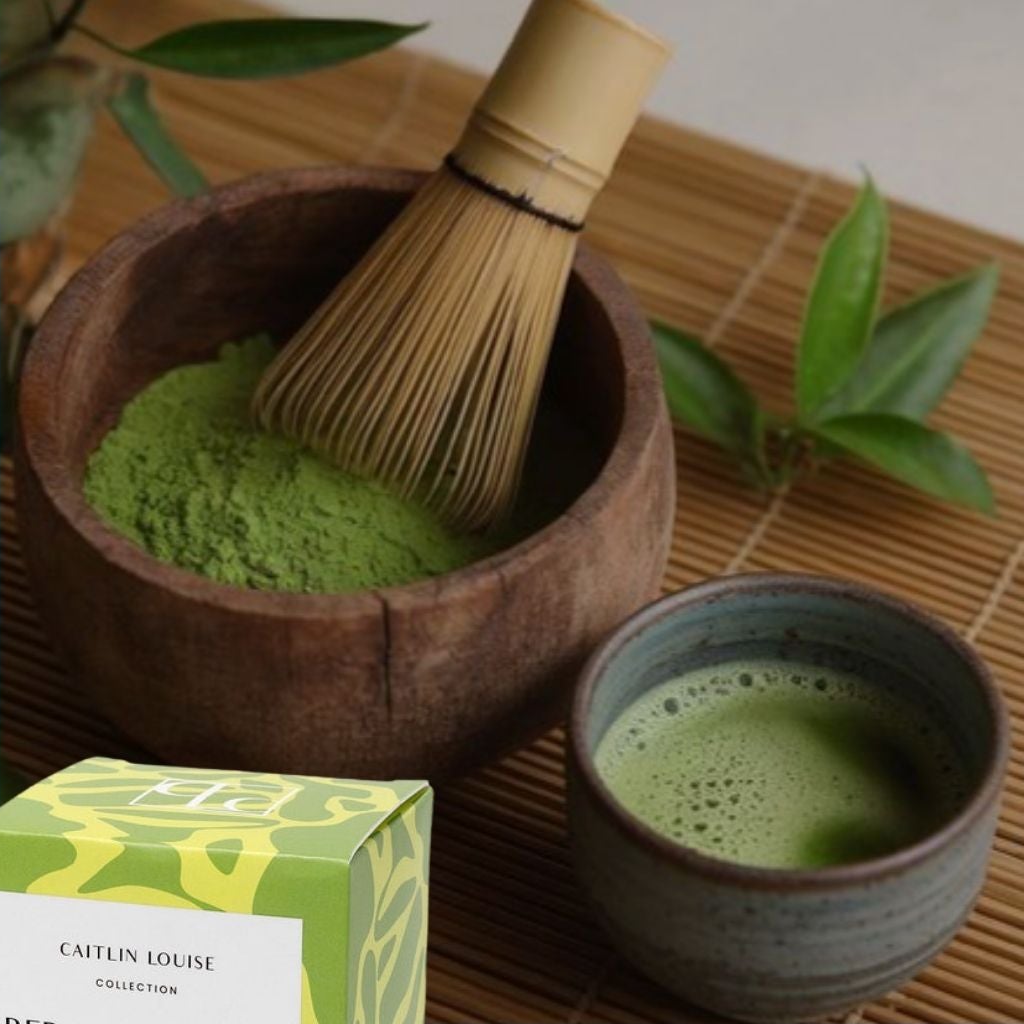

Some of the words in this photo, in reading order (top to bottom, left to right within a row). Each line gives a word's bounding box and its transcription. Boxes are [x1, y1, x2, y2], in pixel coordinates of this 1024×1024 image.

[59, 941, 138, 963] CAITLIN
[147, 950, 216, 972] LOUISE
[95, 978, 178, 996] COLLECTION
